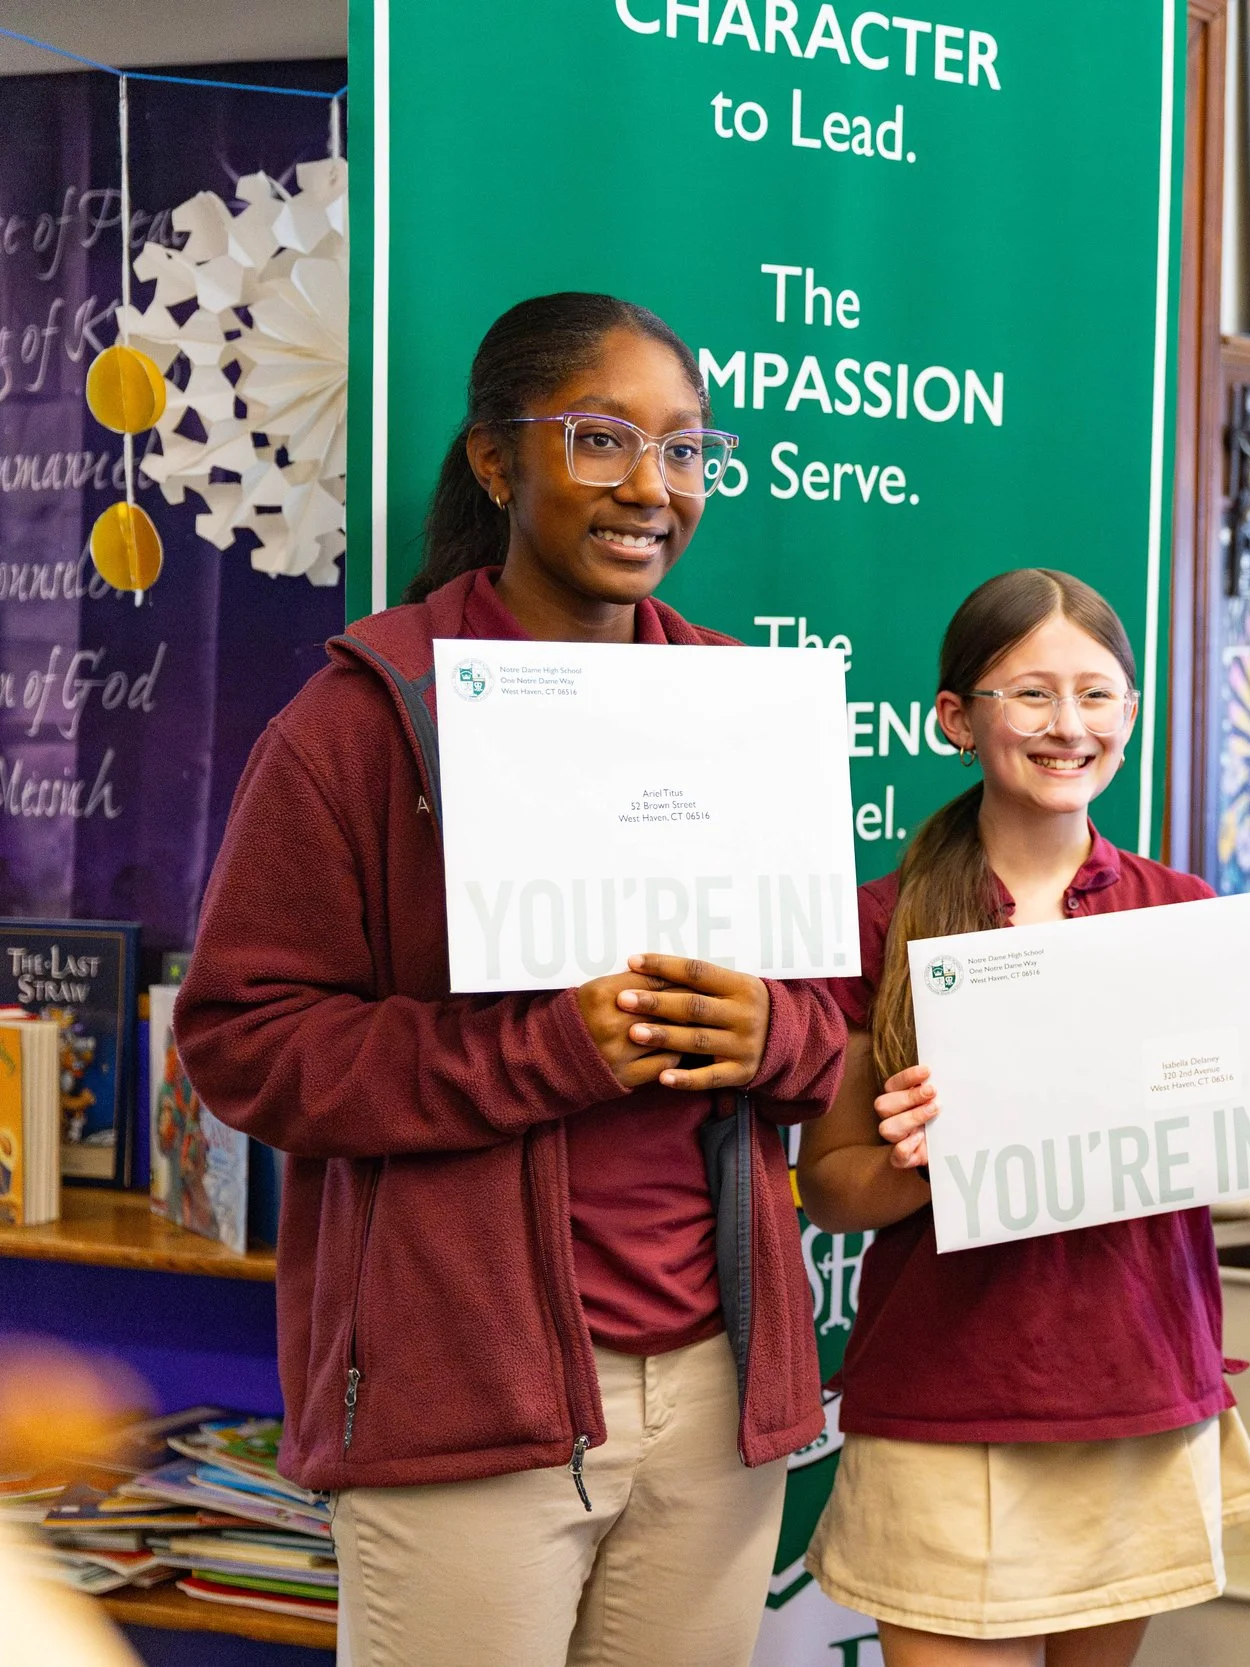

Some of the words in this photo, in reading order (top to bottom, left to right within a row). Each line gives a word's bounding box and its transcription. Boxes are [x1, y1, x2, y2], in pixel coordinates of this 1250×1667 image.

[615, 0, 1001, 90] CHARACTER
[711, 91, 768, 142] to
[792, 89, 917, 163] Lead.
[79, 188, 191, 249] Pea
[761, 263, 861, 330] The
[699, 348, 1005, 426] MPASSION
[770, 441, 919, 506] Serve.
[500, 666, 520, 674] Notre
[543, 667, 559, 675] High
[560, 667, 582, 675] School
[516, 677, 537, 685] Notre
[538, 677, 558, 685] Dame
[559, 677, 575, 686] Way
[58, 641, 168, 740] God
[545, 688, 556, 696] CT
[557, 688, 578, 696] 06516
[847, 701, 960, 757] ENC
[631, 801, 641, 811] 52
[643, 801, 670, 810] Brown
[672, 801, 696, 809] Street
[642, 789, 662, 798] Ariel
[663, 788, 684, 797] Titus
[618, 814, 640, 822] West
[642, 813, 669, 822] Haven,
[670, 812, 684, 821] CT
[685, 811, 711, 821] 06516
[855, 785, 907, 841] el.
[463, 875, 736, 982] YOU'RE
[757, 872, 847, 970] IN!
[8, 947, 45, 978] THE
[50, 943, 101, 980] LAST
[969, 967, 984, 975] One
[985, 965, 1003, 973] Notre
[1004, 962, 1023, 970] Dame
[1023, 959, 1038, 968] Way
[988, 955, 1007, 963] Dame
[1008, 952, 1023, 962] High
[1023, 948, 1044, 957] School
[17, 974, 91, 1004] STRAW
[970, 977, 988, 985] West
[988, 974, 1010, 983] Haven,
[1010, 972, 1021, 980] CT
[1021, 969, 1041, 978] 06516
[1162, 1060, 1188, 1070] Isabella
[1190, 1055, 1220, 1066] Delaney
[1163, 1071, 1177, 1081] 320
[1179, 1070, 1193, 1078] 2nd
[1194, 1066, 1221, 1075] Avenue
[1172, 1081, 1196, 1090] Haven,
[1197, 1077, 1210, 1086] CT
[1211, 1073, 1234, 1084] 06516
[944, 1116, 1195, 1239] YOU'RE
